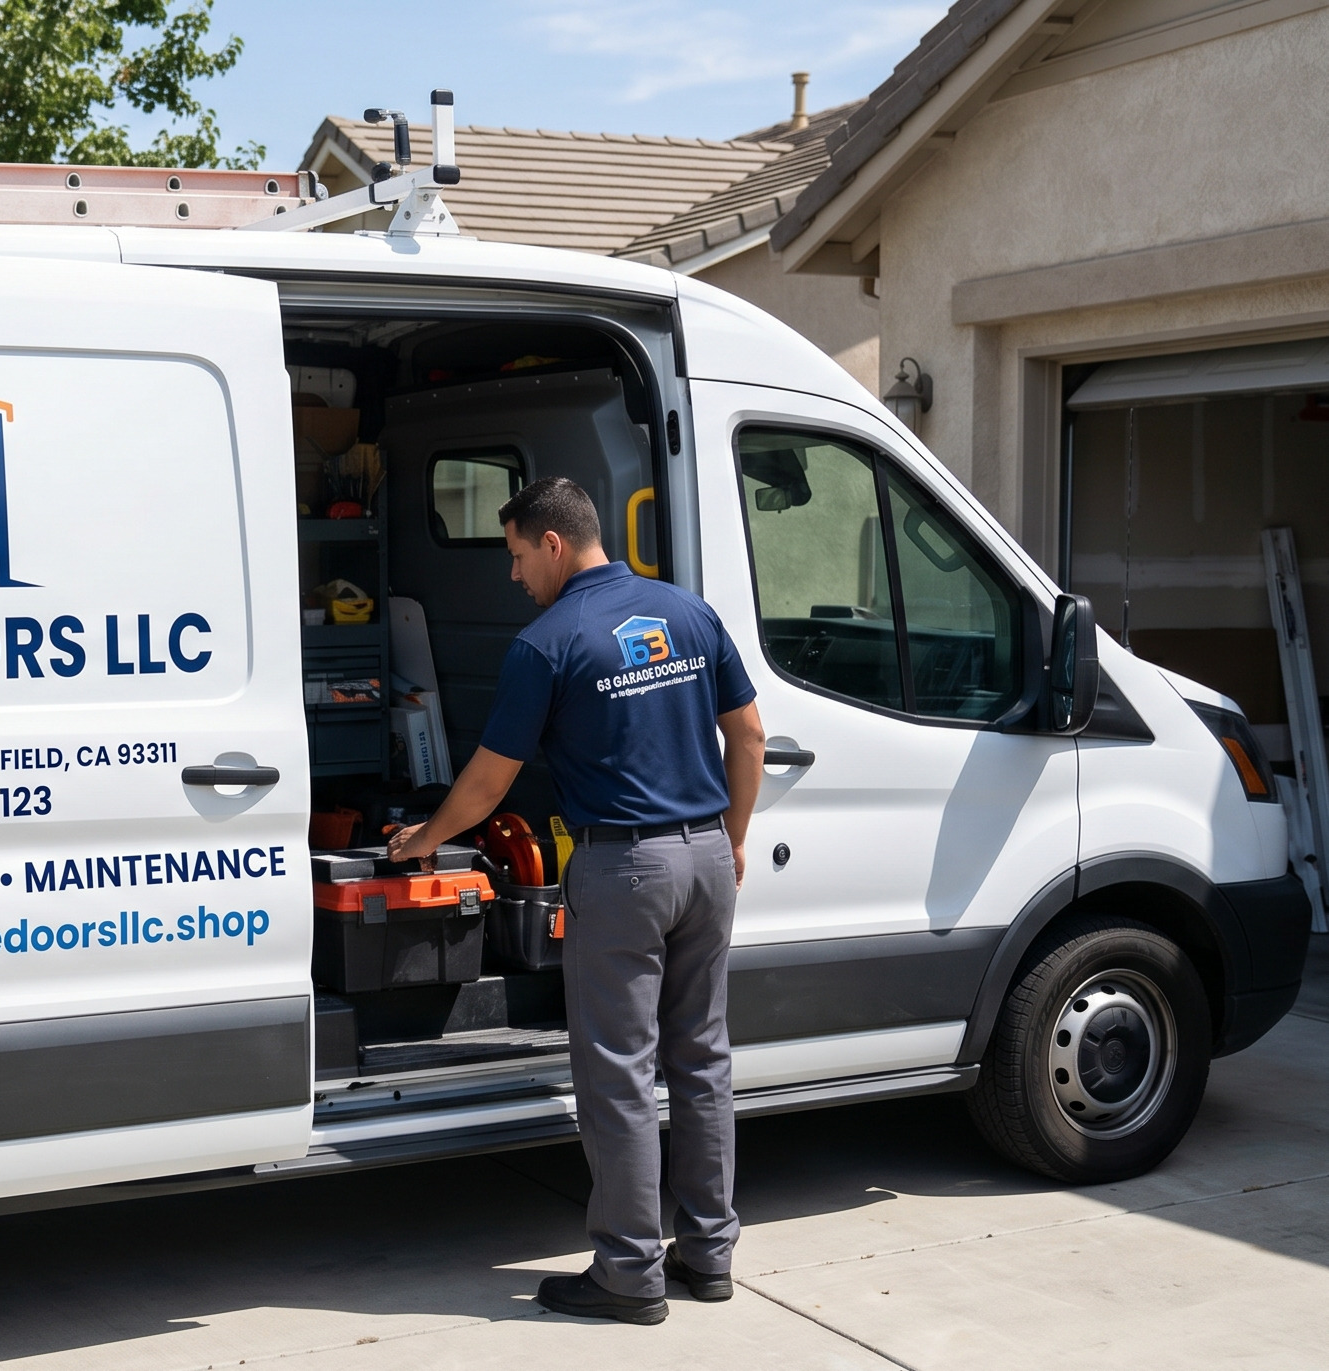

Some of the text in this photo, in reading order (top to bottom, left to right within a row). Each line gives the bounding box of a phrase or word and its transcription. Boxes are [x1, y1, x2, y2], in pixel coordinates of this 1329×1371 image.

[105, 612, 213, 676] LLC
[626, 630, 669, 665] 63
[597, 678, 611, 692] 63
[655, 659, 689, 678] DOORS
[77, 745, 111, 767] CA
[117, 741, 177, 765] 93311
[24, 846, 286, 893] MAINTENANCE
